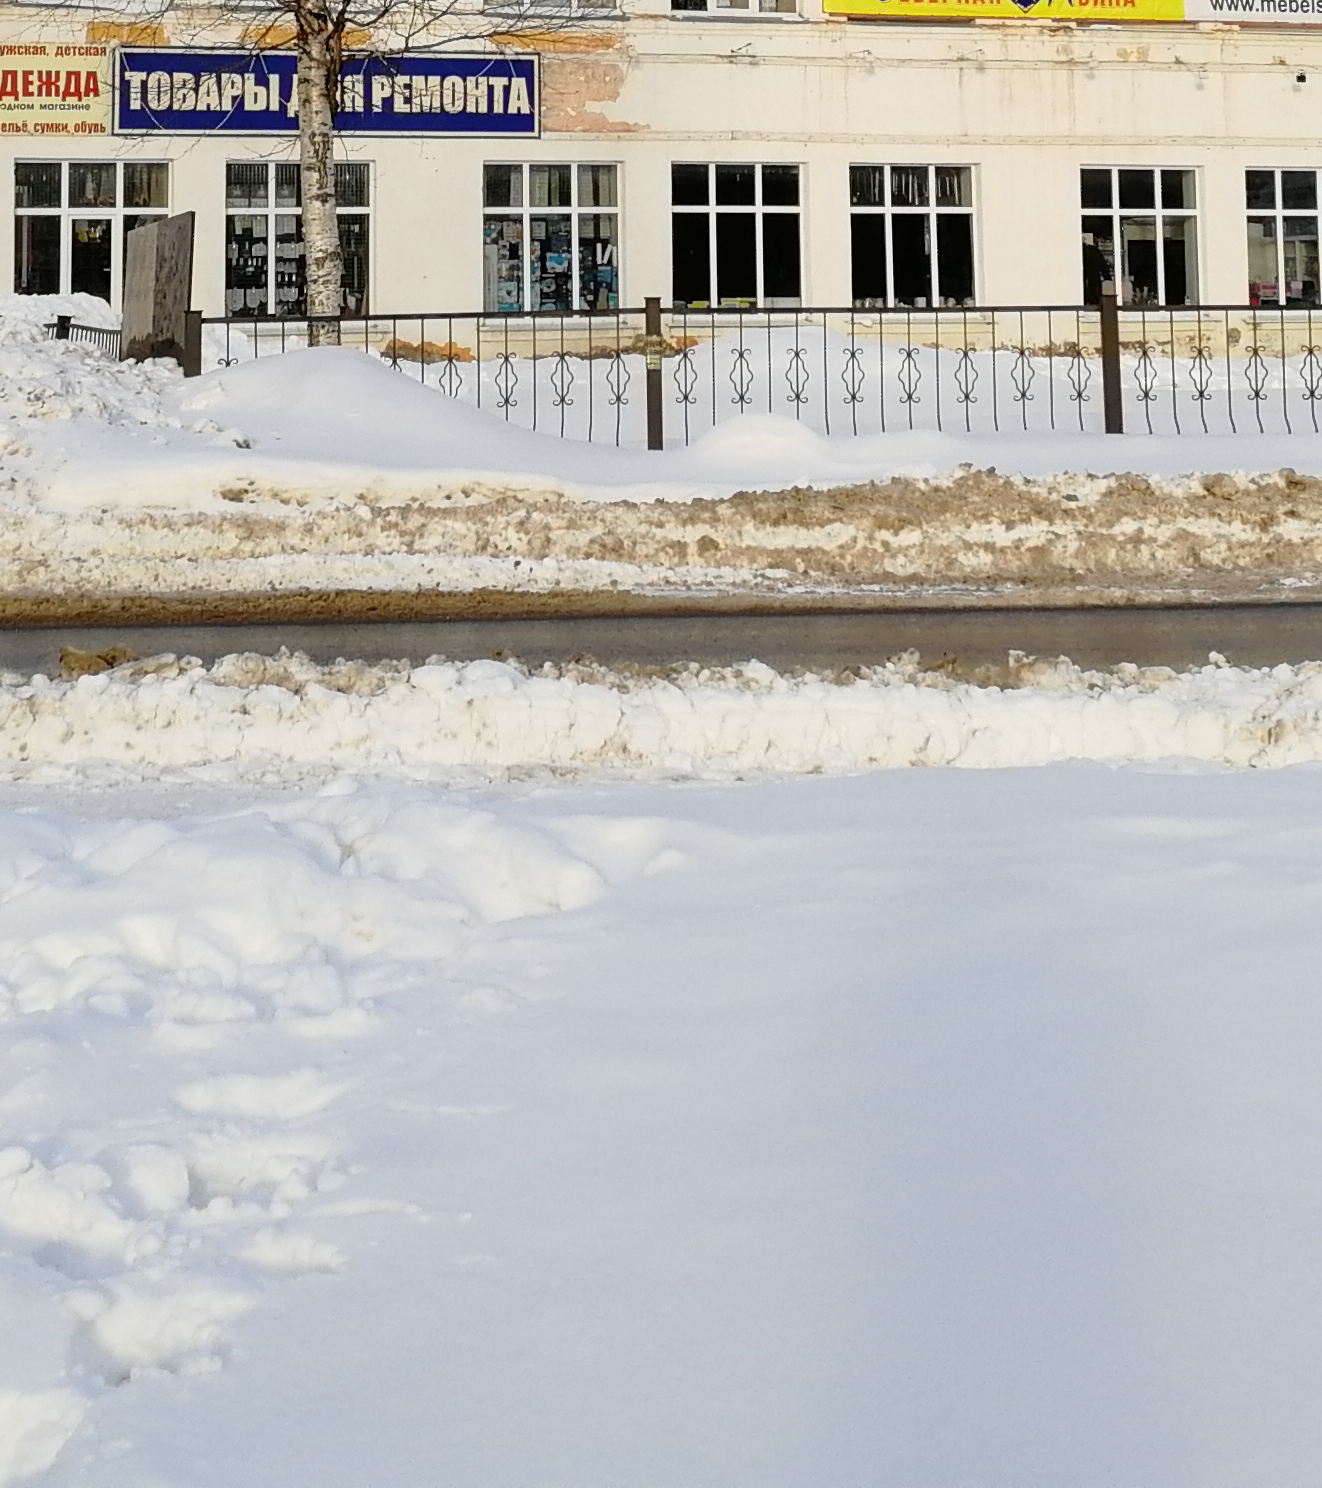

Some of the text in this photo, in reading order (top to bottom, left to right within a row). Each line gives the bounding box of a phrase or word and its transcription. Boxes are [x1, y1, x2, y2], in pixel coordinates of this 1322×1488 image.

[55, 45, 107, 58] детская
[124, 71, 280, 112] ТОВАРЫ
[372, 74, 530, 114] РЕМОНТА
[0, 103, 34, 112] одном
[39, 103, 91, 112] магазине
[74, 121, 106, 135] обувь
